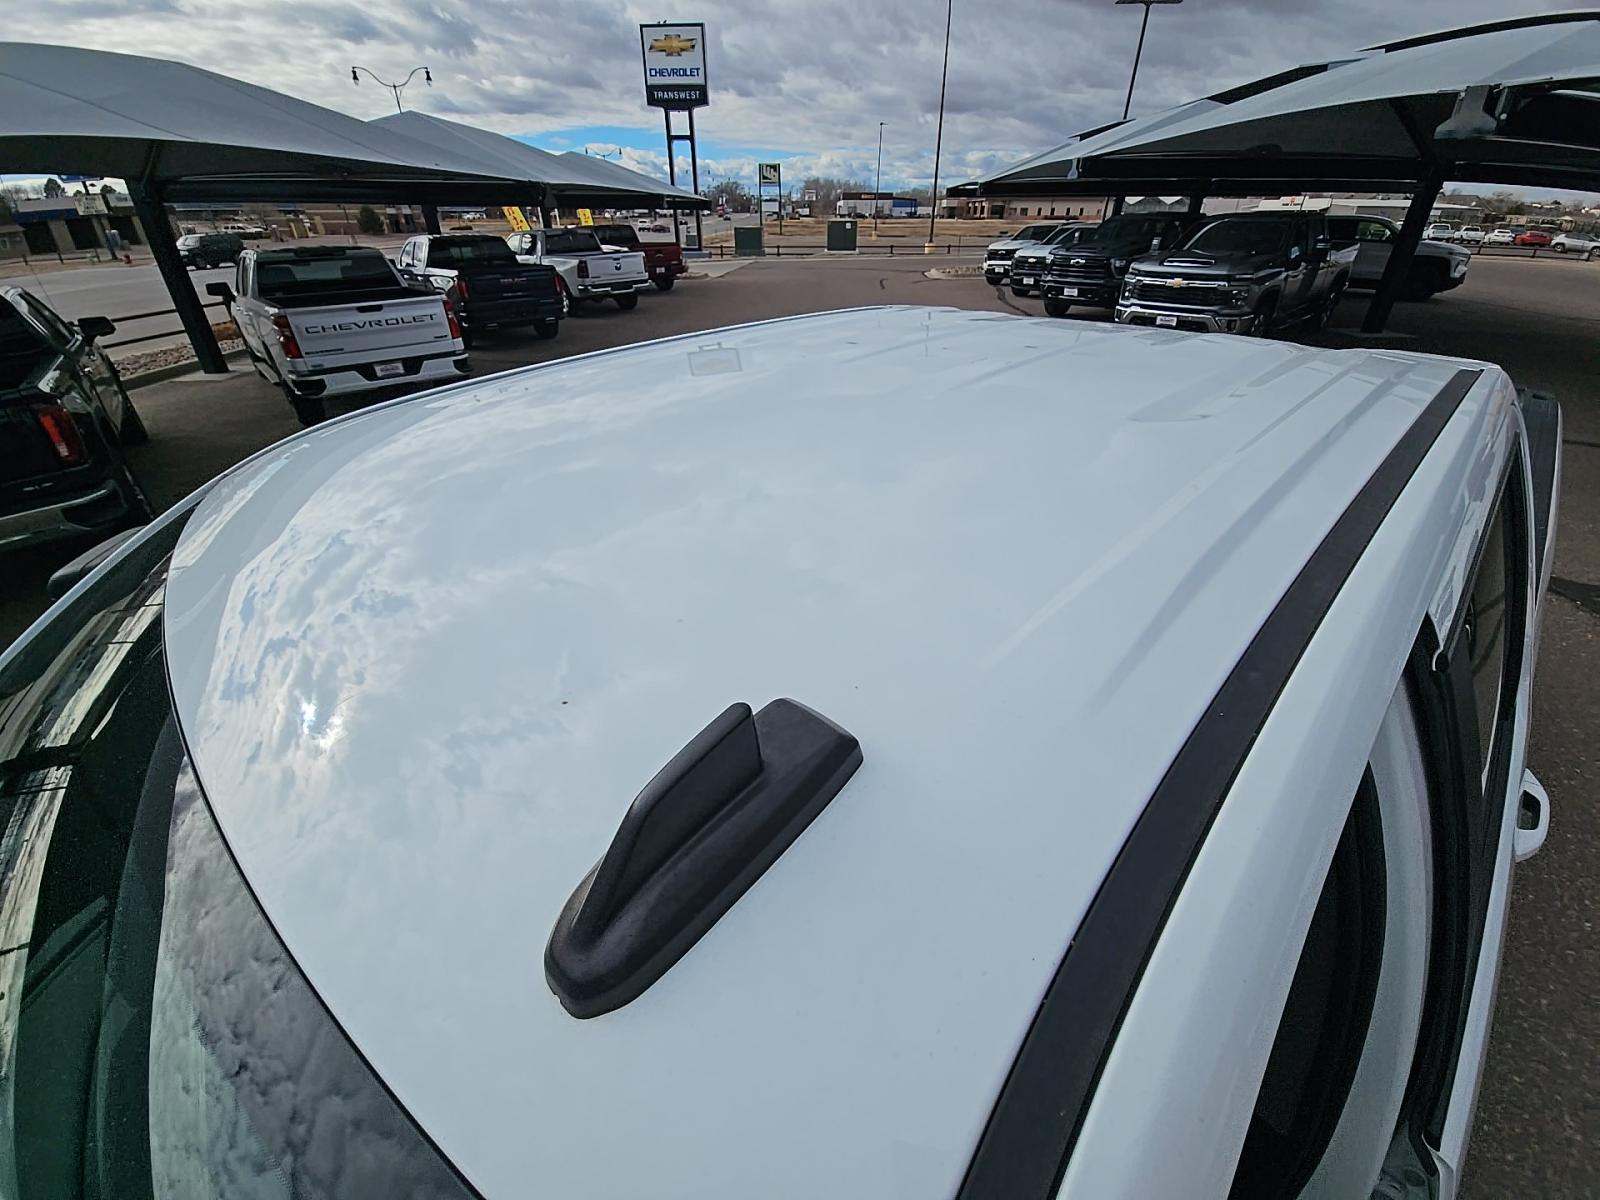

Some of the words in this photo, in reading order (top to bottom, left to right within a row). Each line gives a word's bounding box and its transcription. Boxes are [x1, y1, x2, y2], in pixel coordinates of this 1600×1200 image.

[649, 67, 700, 77] CHEVROLET
[654, 91, 700, 99] TRANSWEST
[305, 313, 437, 334] CHEVROLET
